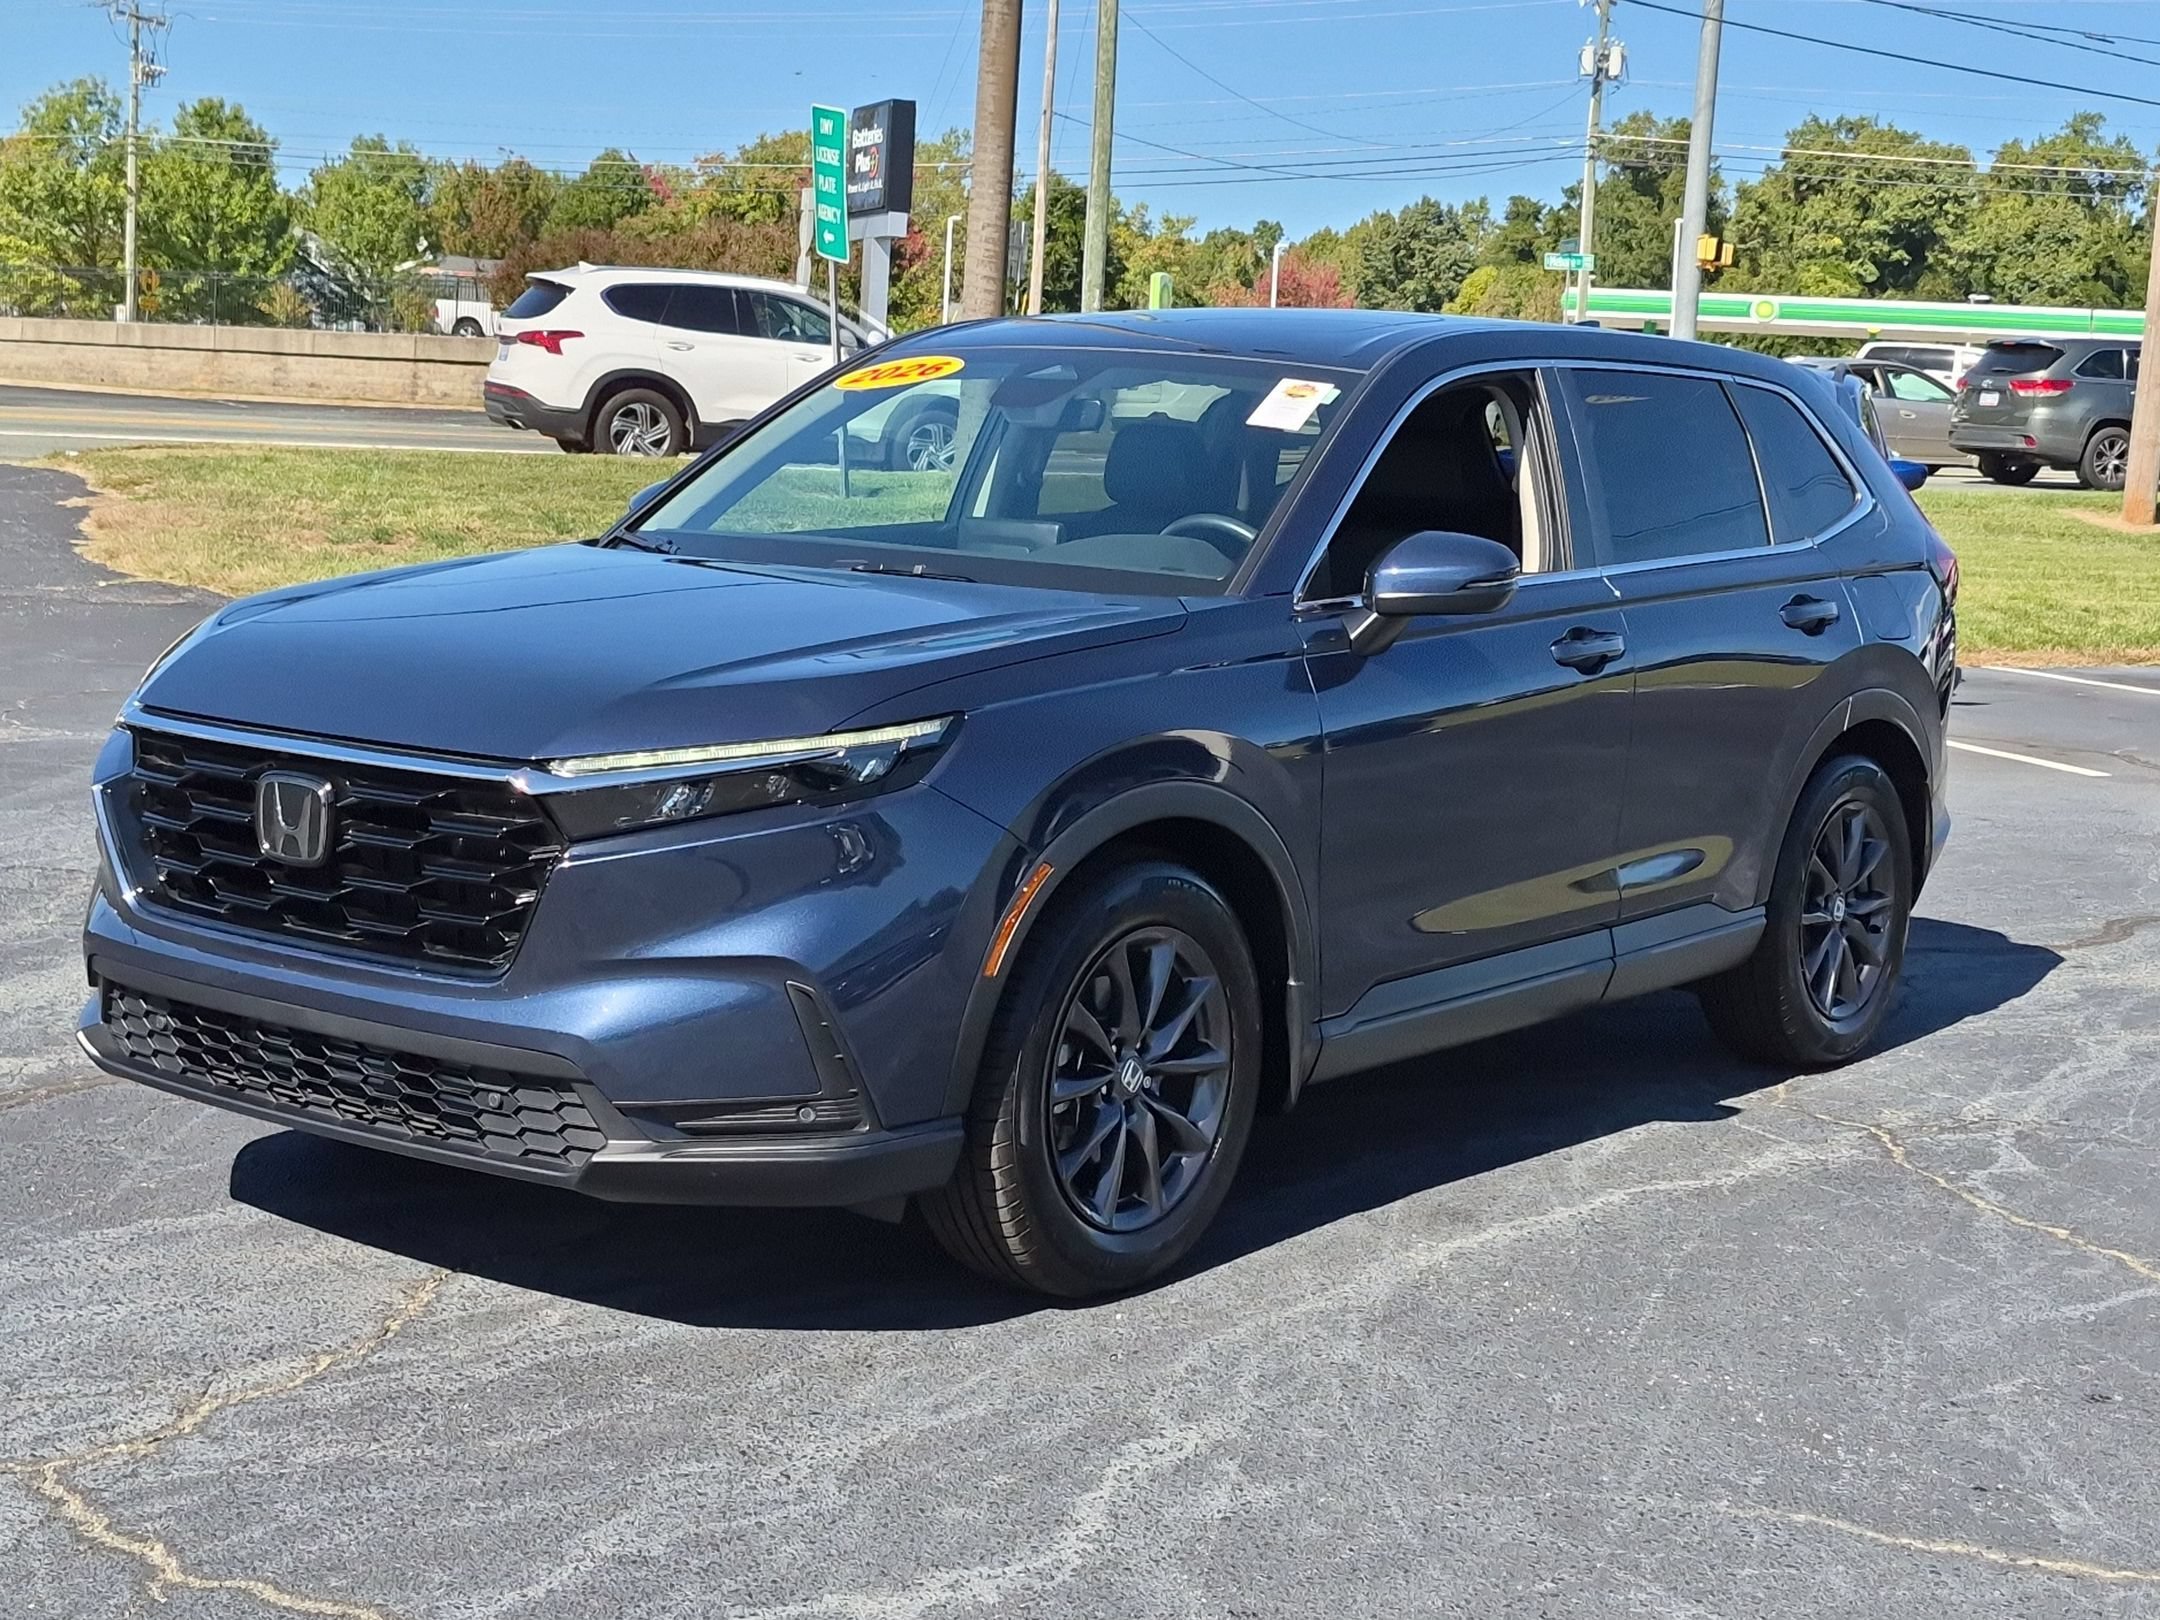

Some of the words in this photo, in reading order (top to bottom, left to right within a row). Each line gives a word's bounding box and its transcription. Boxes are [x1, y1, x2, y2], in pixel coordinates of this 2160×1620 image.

[852, 123, 883, 149] Batteries
[815, 146, 840, 166] LICENSE
[818, 174, 836, 194] PLATE
[818, 203, 841, 224] AGENCY
[843, 361, 952, 385] 2026
